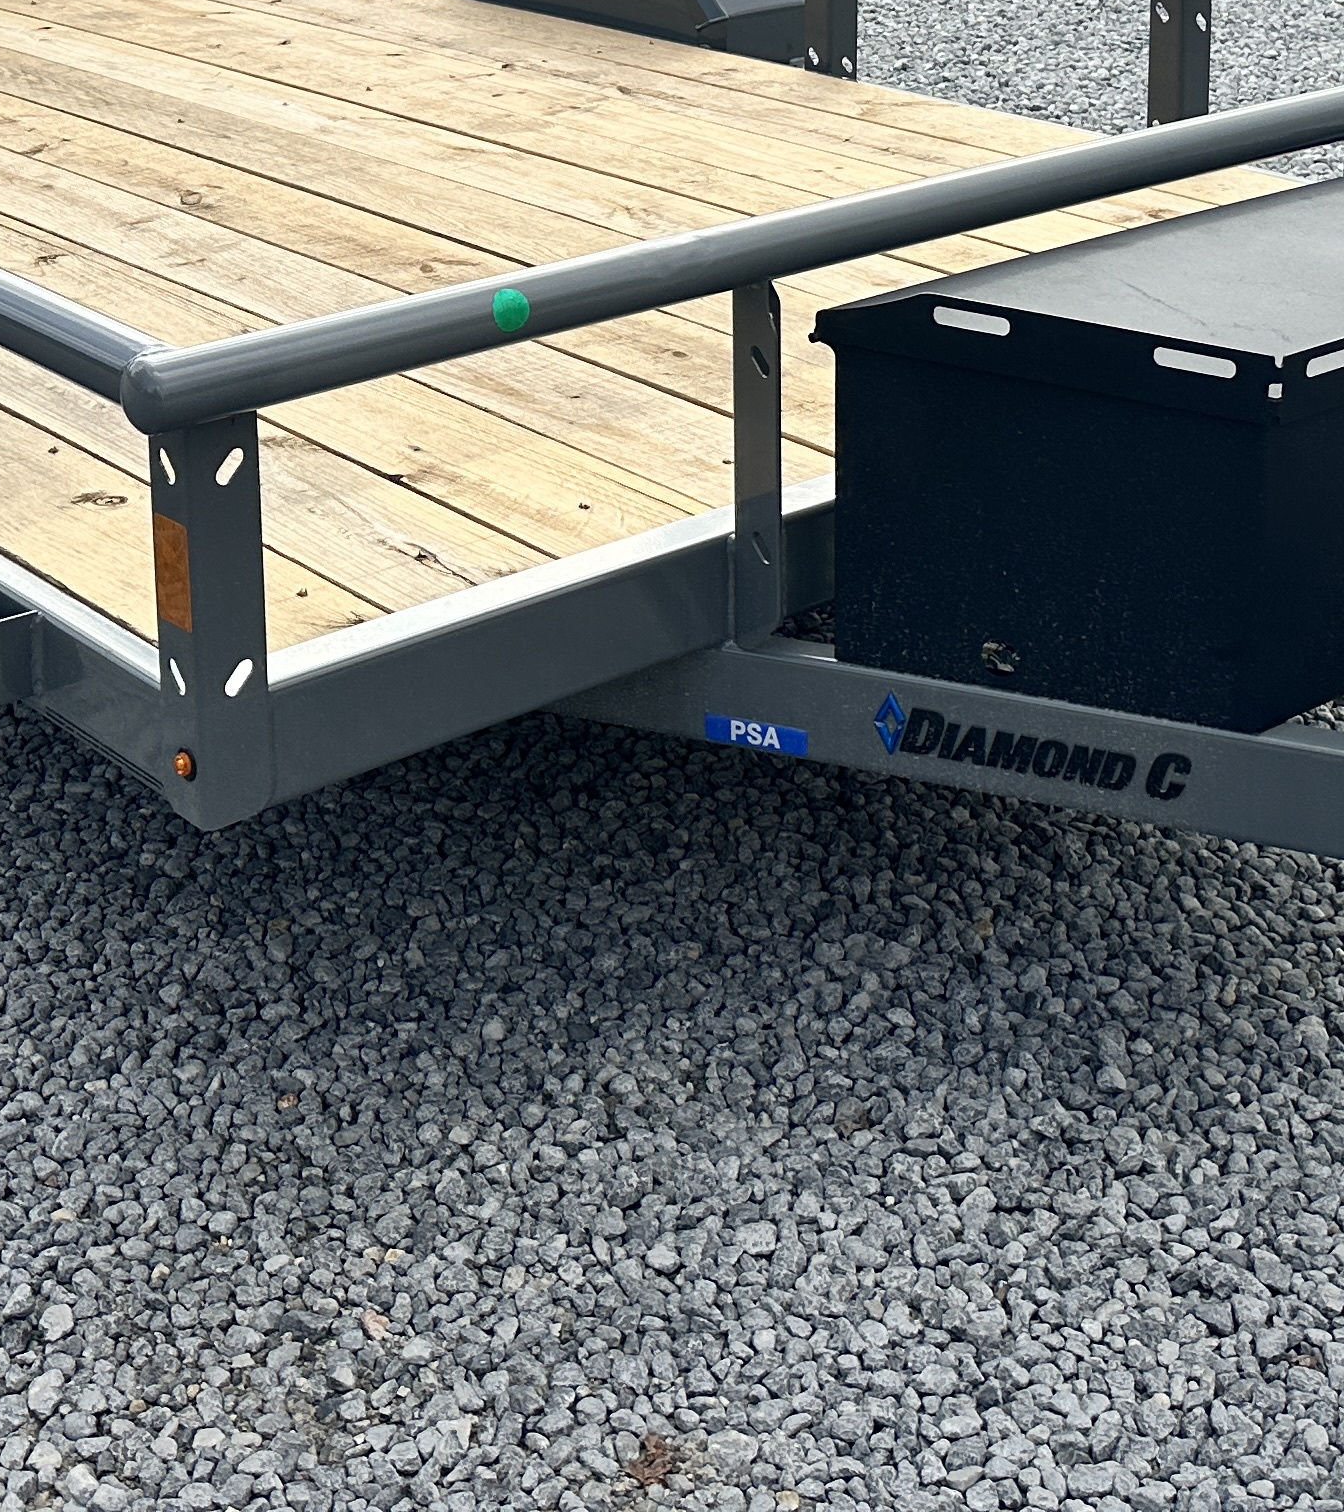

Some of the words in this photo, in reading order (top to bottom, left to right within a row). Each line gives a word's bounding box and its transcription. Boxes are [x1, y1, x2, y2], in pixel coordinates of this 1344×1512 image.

[729, 719, 782, 750] PSA
[899, 707, 1137, 791] DIAMOND
[1145, 752, 1193, 801] C
